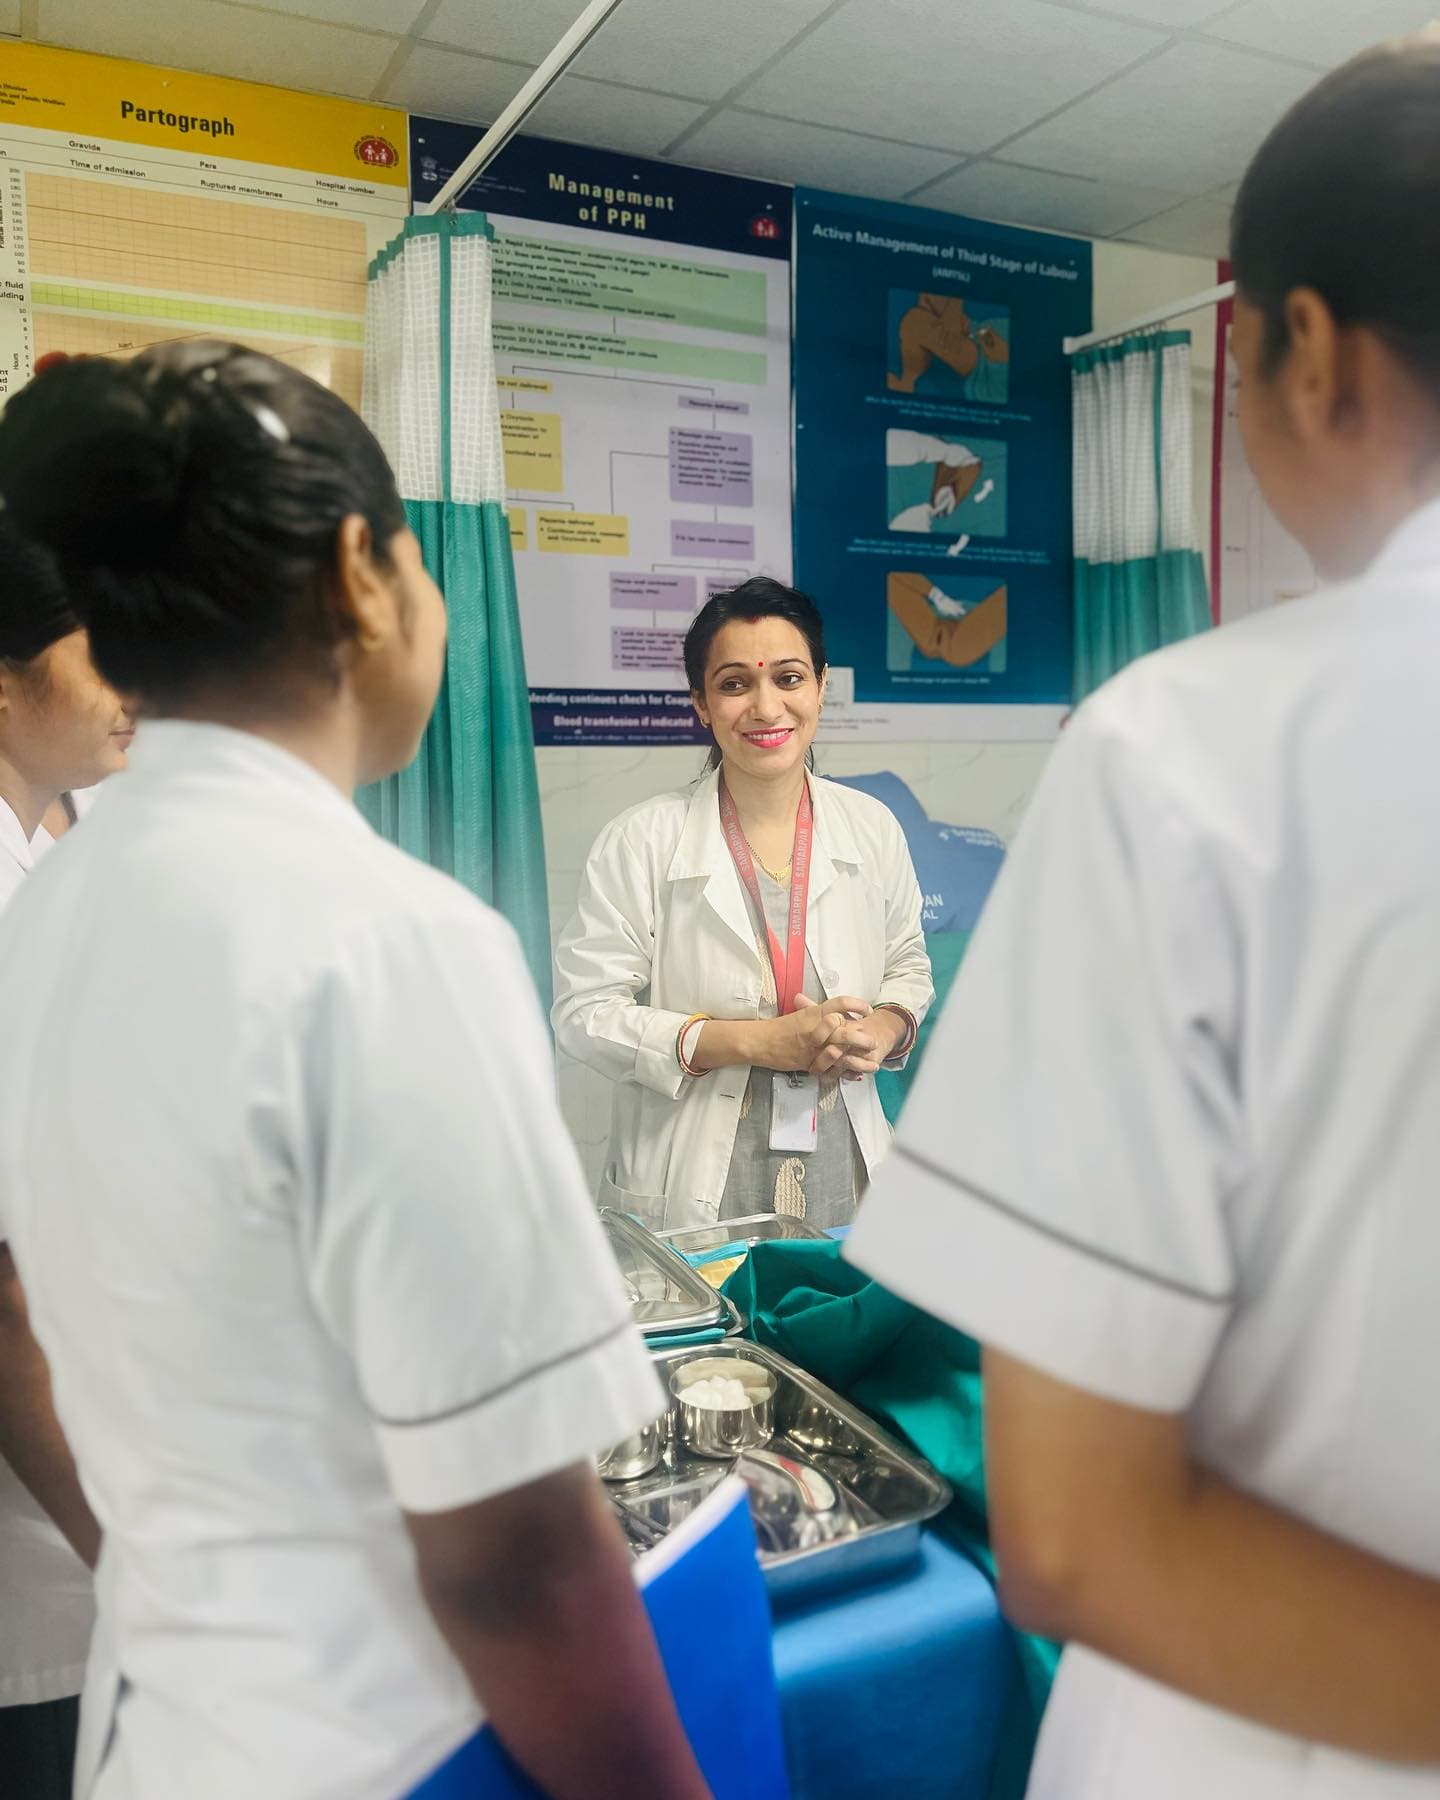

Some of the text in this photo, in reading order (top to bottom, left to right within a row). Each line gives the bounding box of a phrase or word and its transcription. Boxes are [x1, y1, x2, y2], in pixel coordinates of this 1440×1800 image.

[121, 100, 234, 137] Partograph
[70, 159, 146, 177] Time of admission
[200, 179, 283, 199] Ruptured membranes
[316, 180, 375, 195] Hospital number
[549, 173, 675, 211] Management
[317, 197, 338, 207] Hours
[578, 204, 646, 231] of PPH
[812, 224, 1079, 281] Active Management of Third Stage of Labour
[5, 280, 24, 290] fluid
[570, 694, 618, 705] continues
[619, 694, 647, 706] check
[648, 694, 662, 705] for
[554, 715, 694, 728] Blood transfusion if indicated
[727, 822, 750, 874] SAMARPAN
[796, 828, 808, 878] SAMARPAN
[792, 884, 804, 936] SAMARPAN
